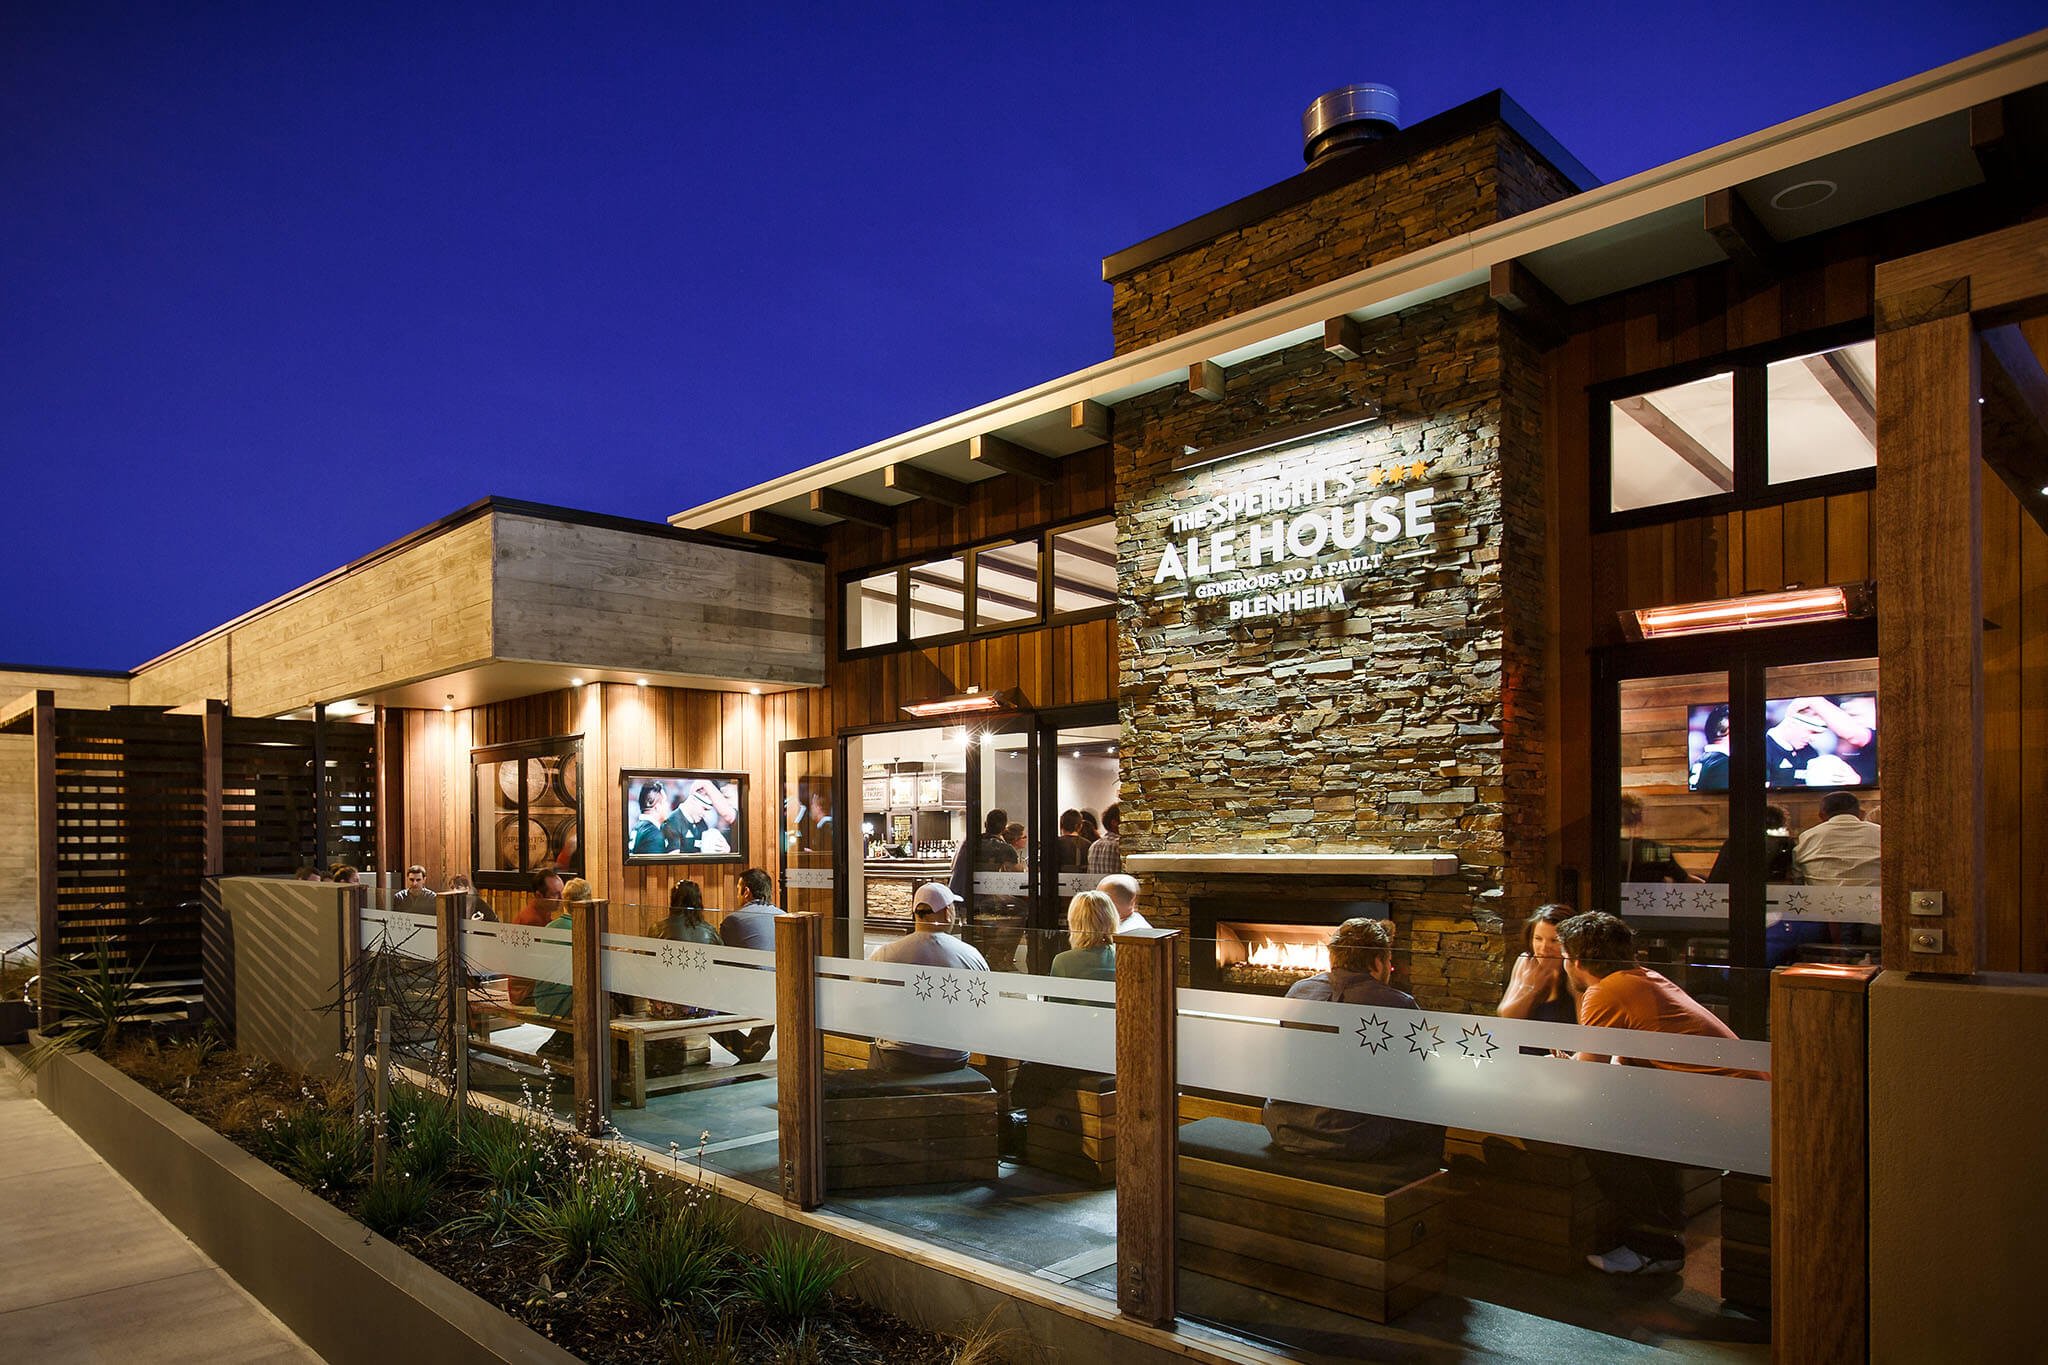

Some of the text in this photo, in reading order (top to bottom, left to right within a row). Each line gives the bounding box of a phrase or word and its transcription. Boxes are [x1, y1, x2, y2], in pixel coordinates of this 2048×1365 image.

[1172, 469, 1355, 533] THE SPEIGHT'S
[1153, 487, 1435, 584] ALE HOUSE
[1195, 554, 1382, 599] GENEROUS TO A FAULT
[1230, 584, 1345, 620] BLENHEIM
